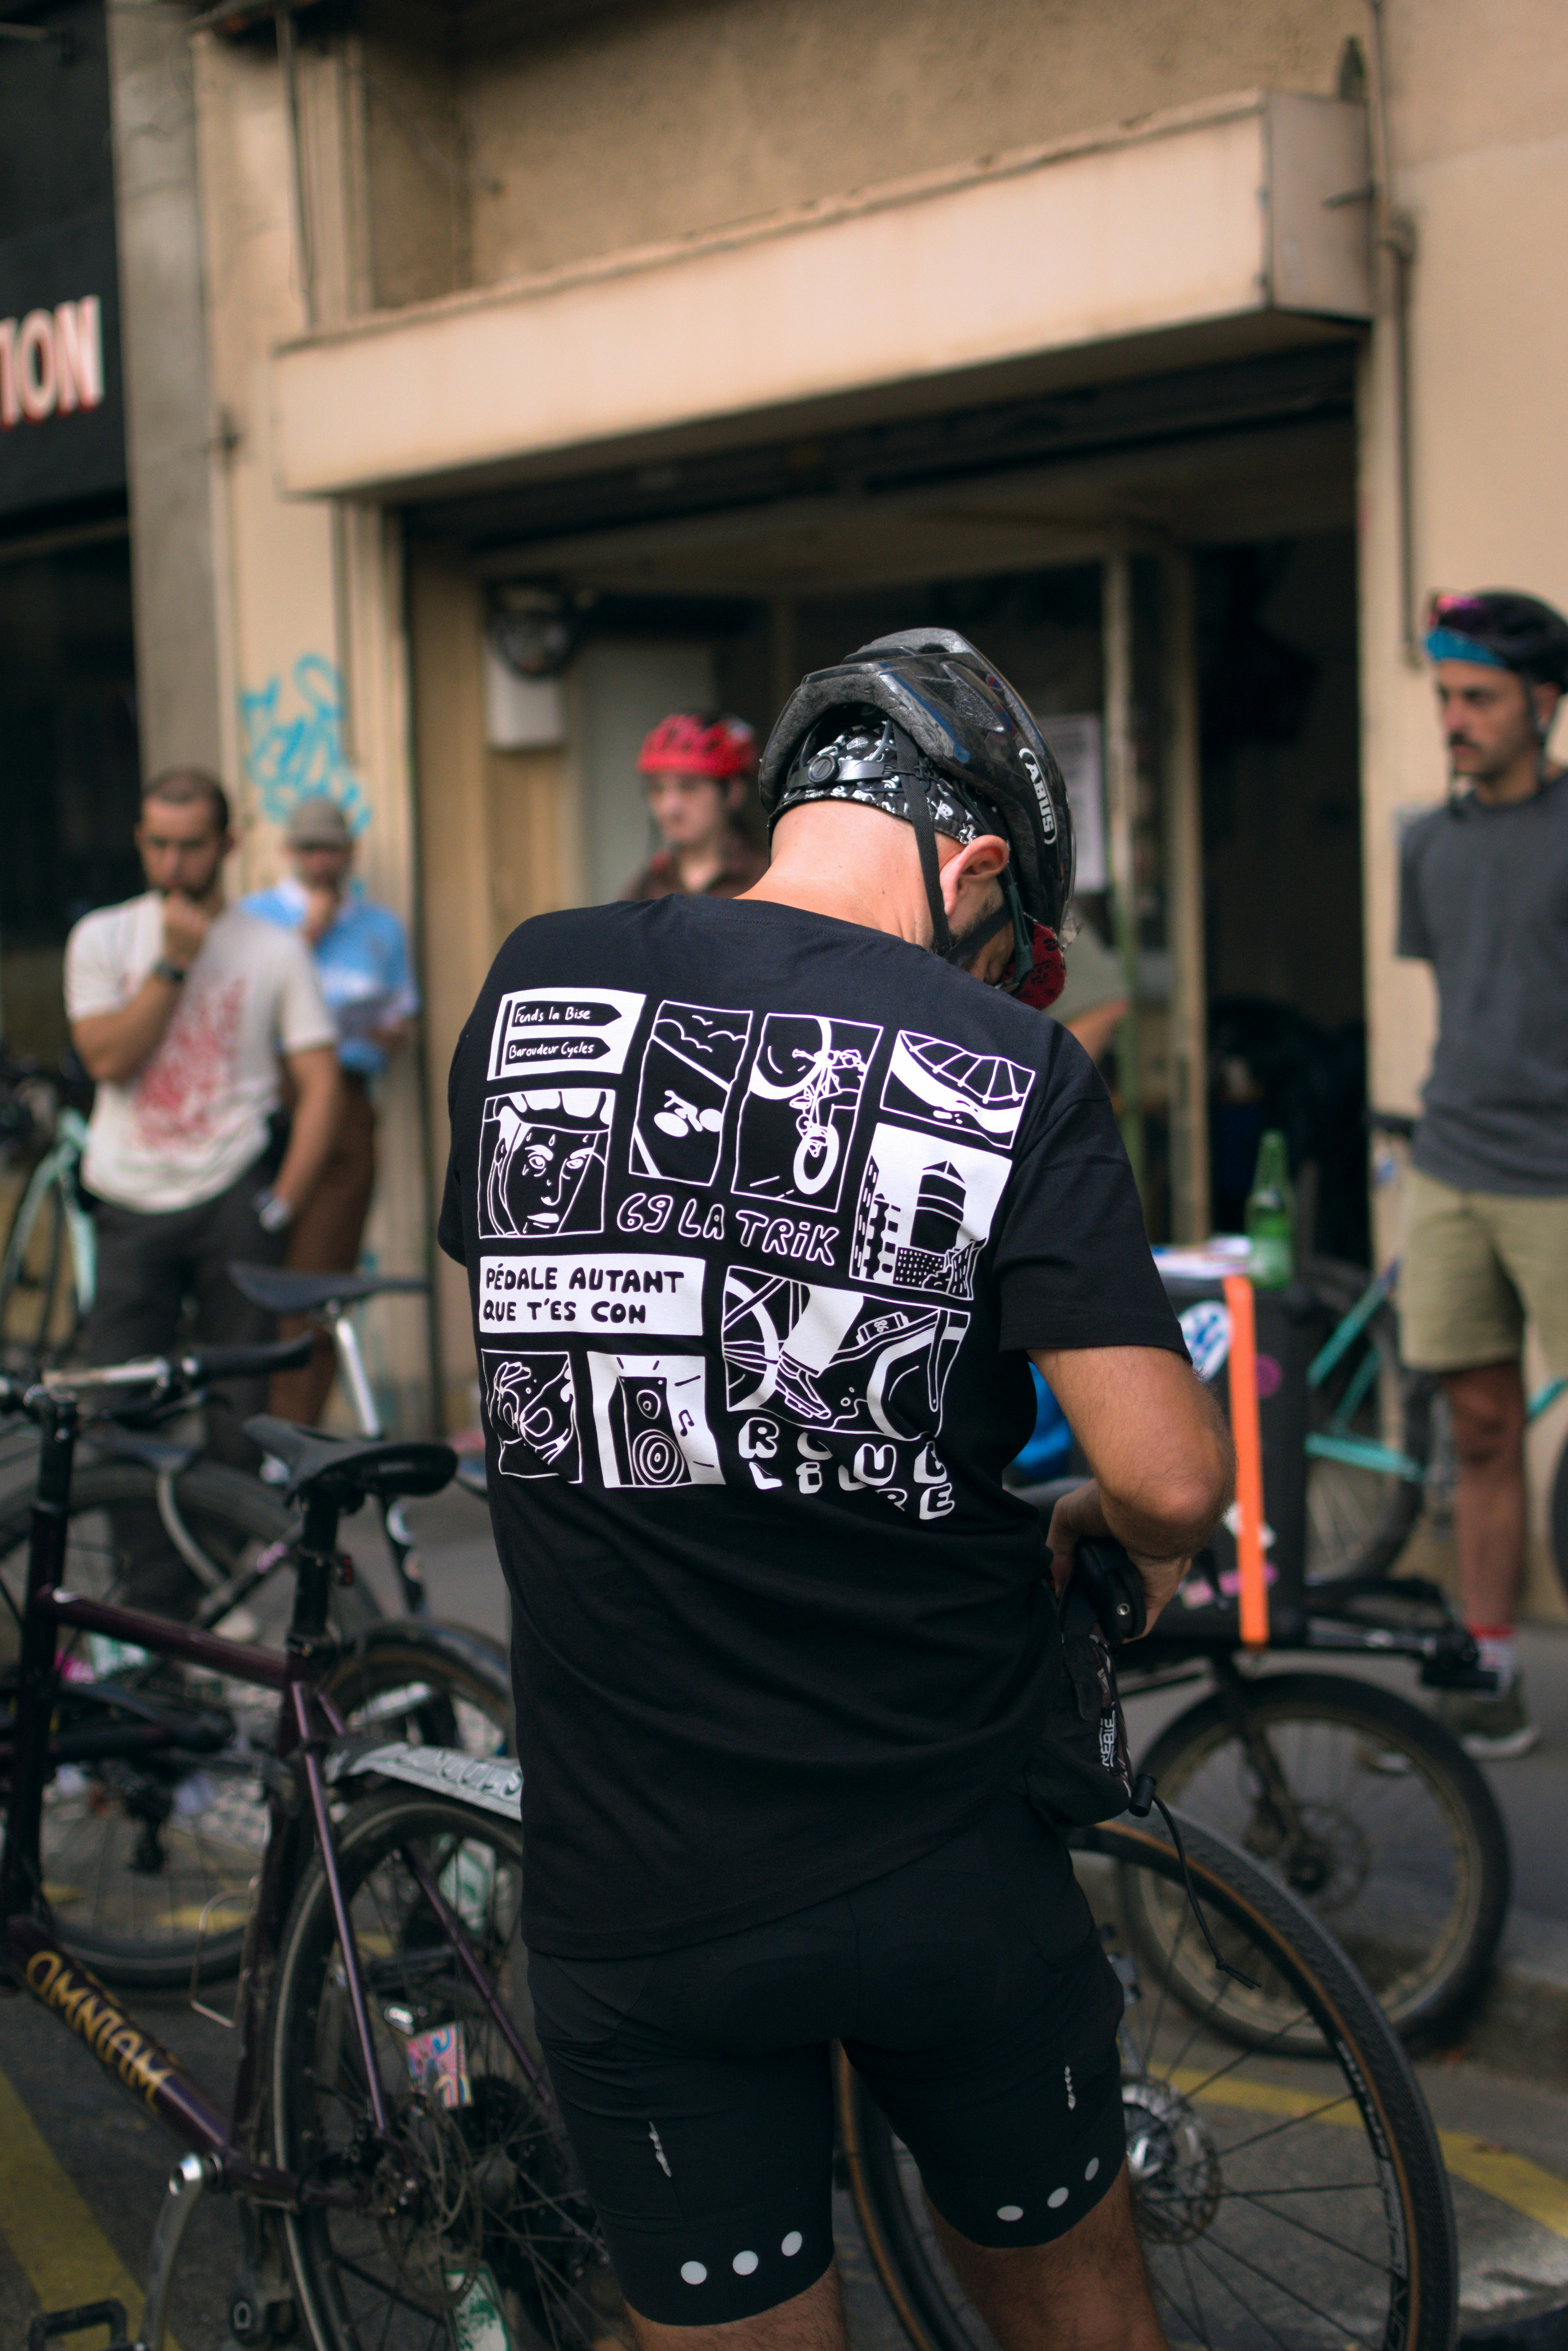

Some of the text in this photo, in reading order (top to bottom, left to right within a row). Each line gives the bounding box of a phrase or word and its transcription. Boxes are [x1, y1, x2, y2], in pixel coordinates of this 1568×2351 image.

[0, 293, 106, 430] ION
[1025, 762, 1055, 833] ABUS
[514, 1006, 590, 1023] Fends la Bise
[509, 1041, 595, 1059] Baroudeur Cycles
[617, 1192, 674, 1233] 69
[678, 1198, 725, 1240] LA
[486, 1263, 685, 1294] PÉDALE AUTANT
[483, 1298, 646, 1324] QUE T'ES CON
